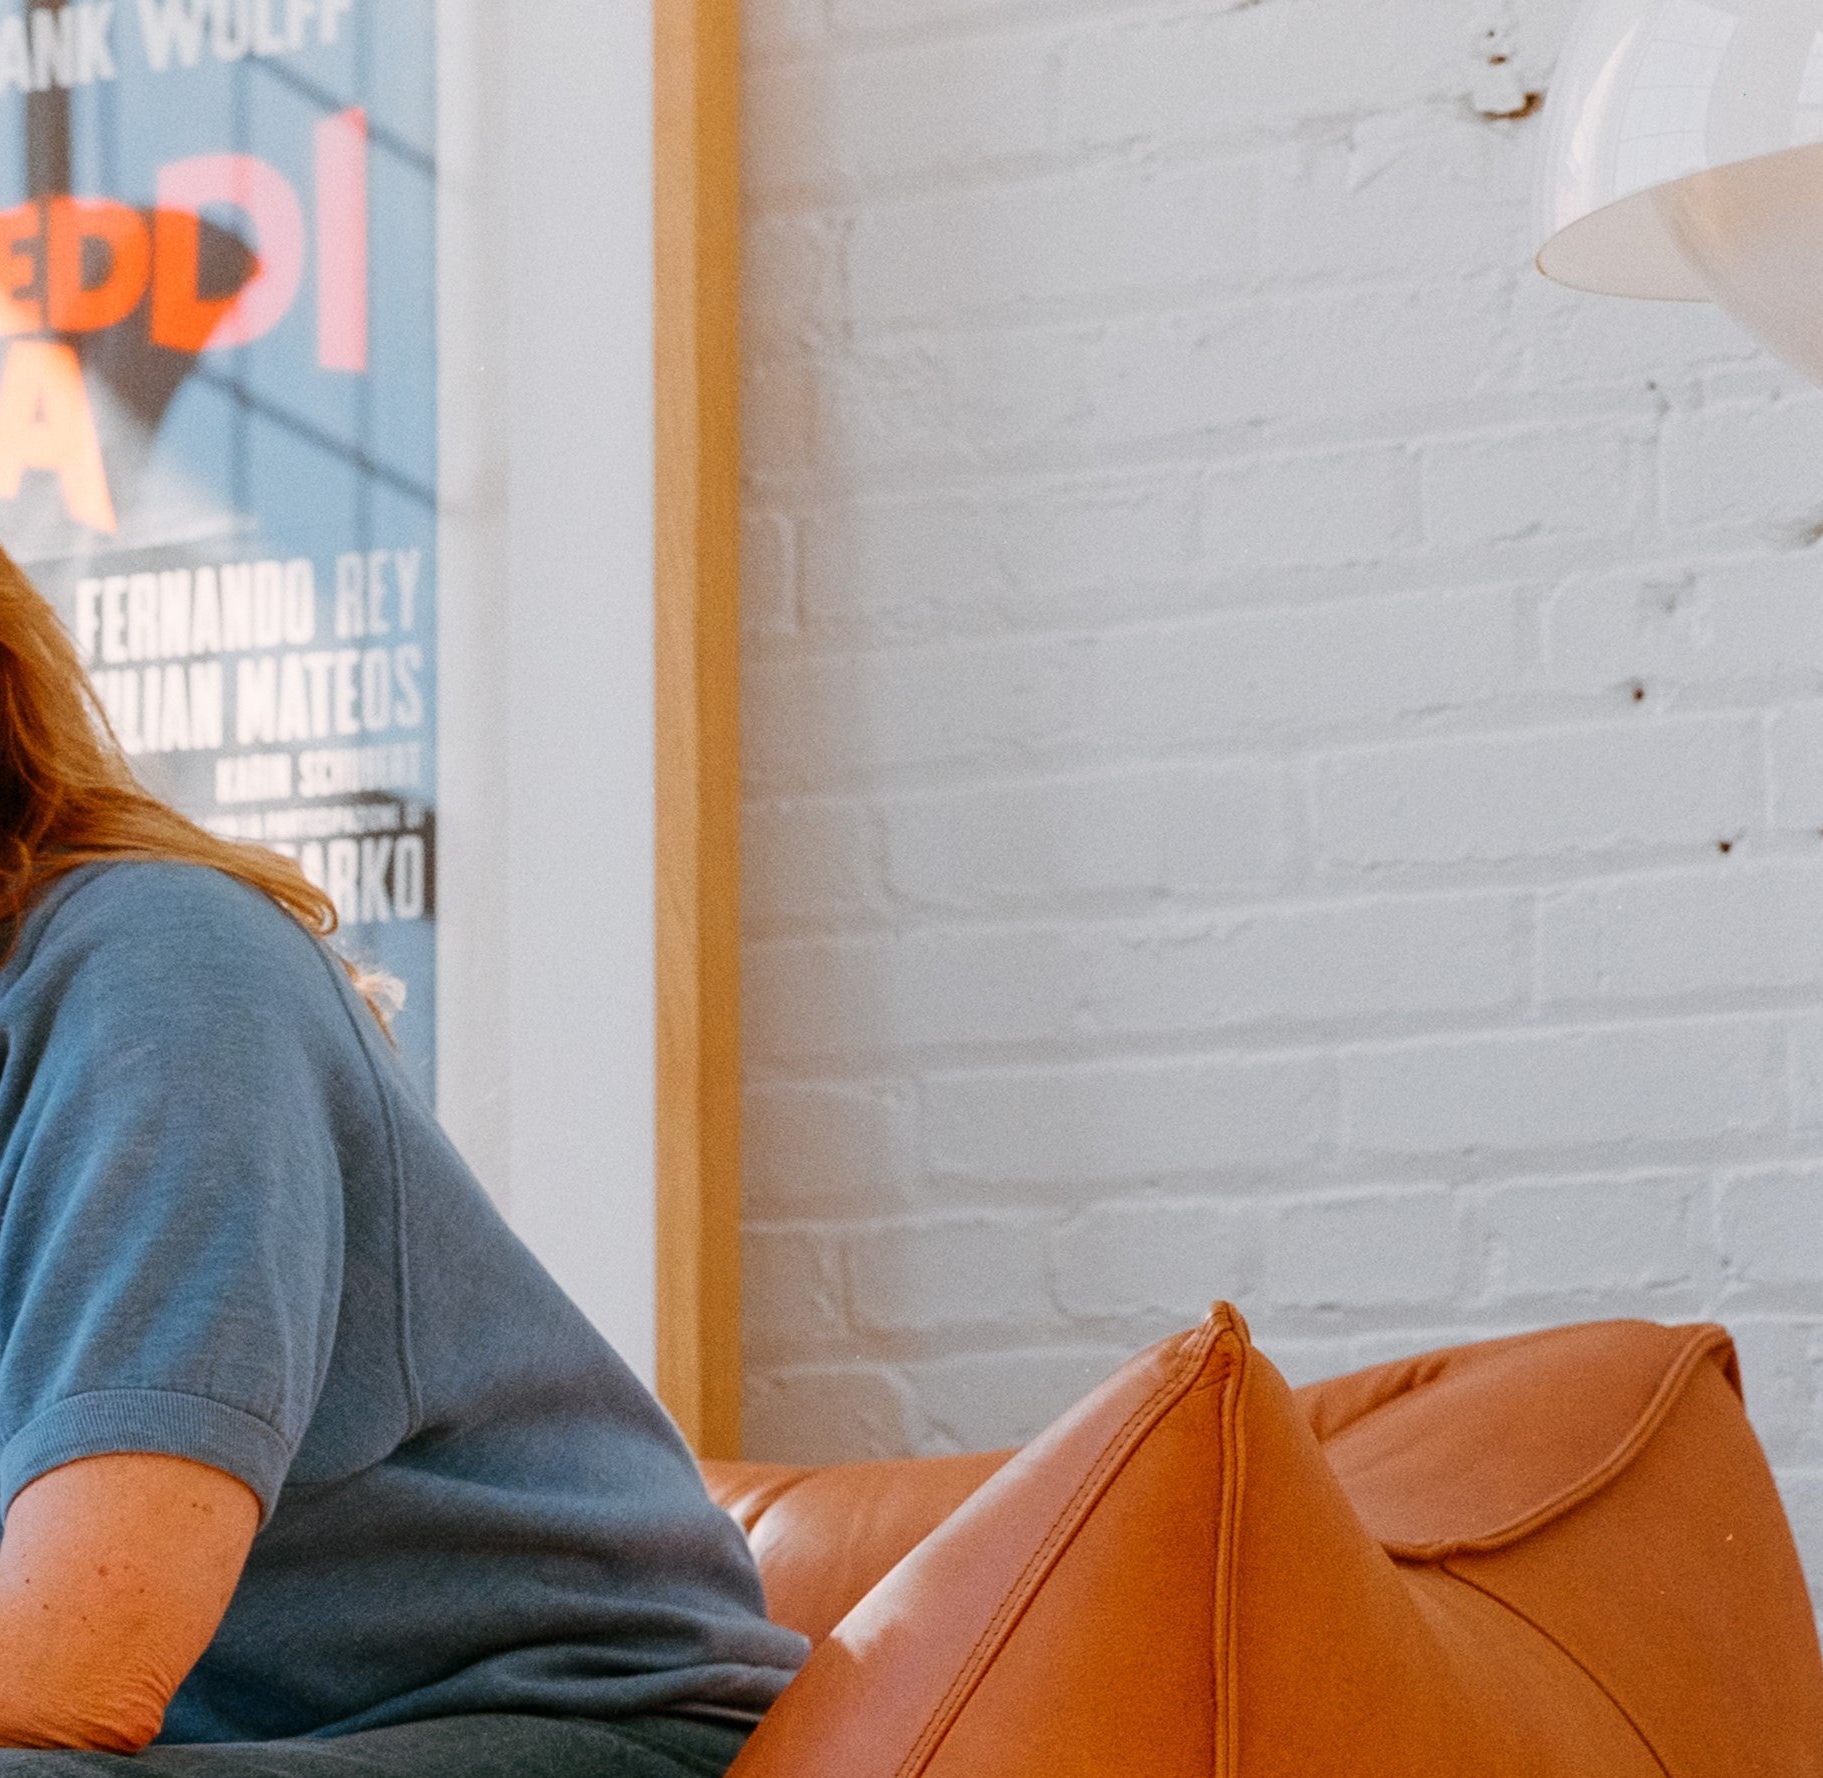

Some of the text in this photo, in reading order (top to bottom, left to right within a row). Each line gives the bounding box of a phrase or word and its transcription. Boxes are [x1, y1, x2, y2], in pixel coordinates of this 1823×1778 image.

[76, 550, 422, 663] FERNANDO REY
[87, 644, 424, 755] ULIAN MATEOS
[273, 834, 425, 925] ARKO
